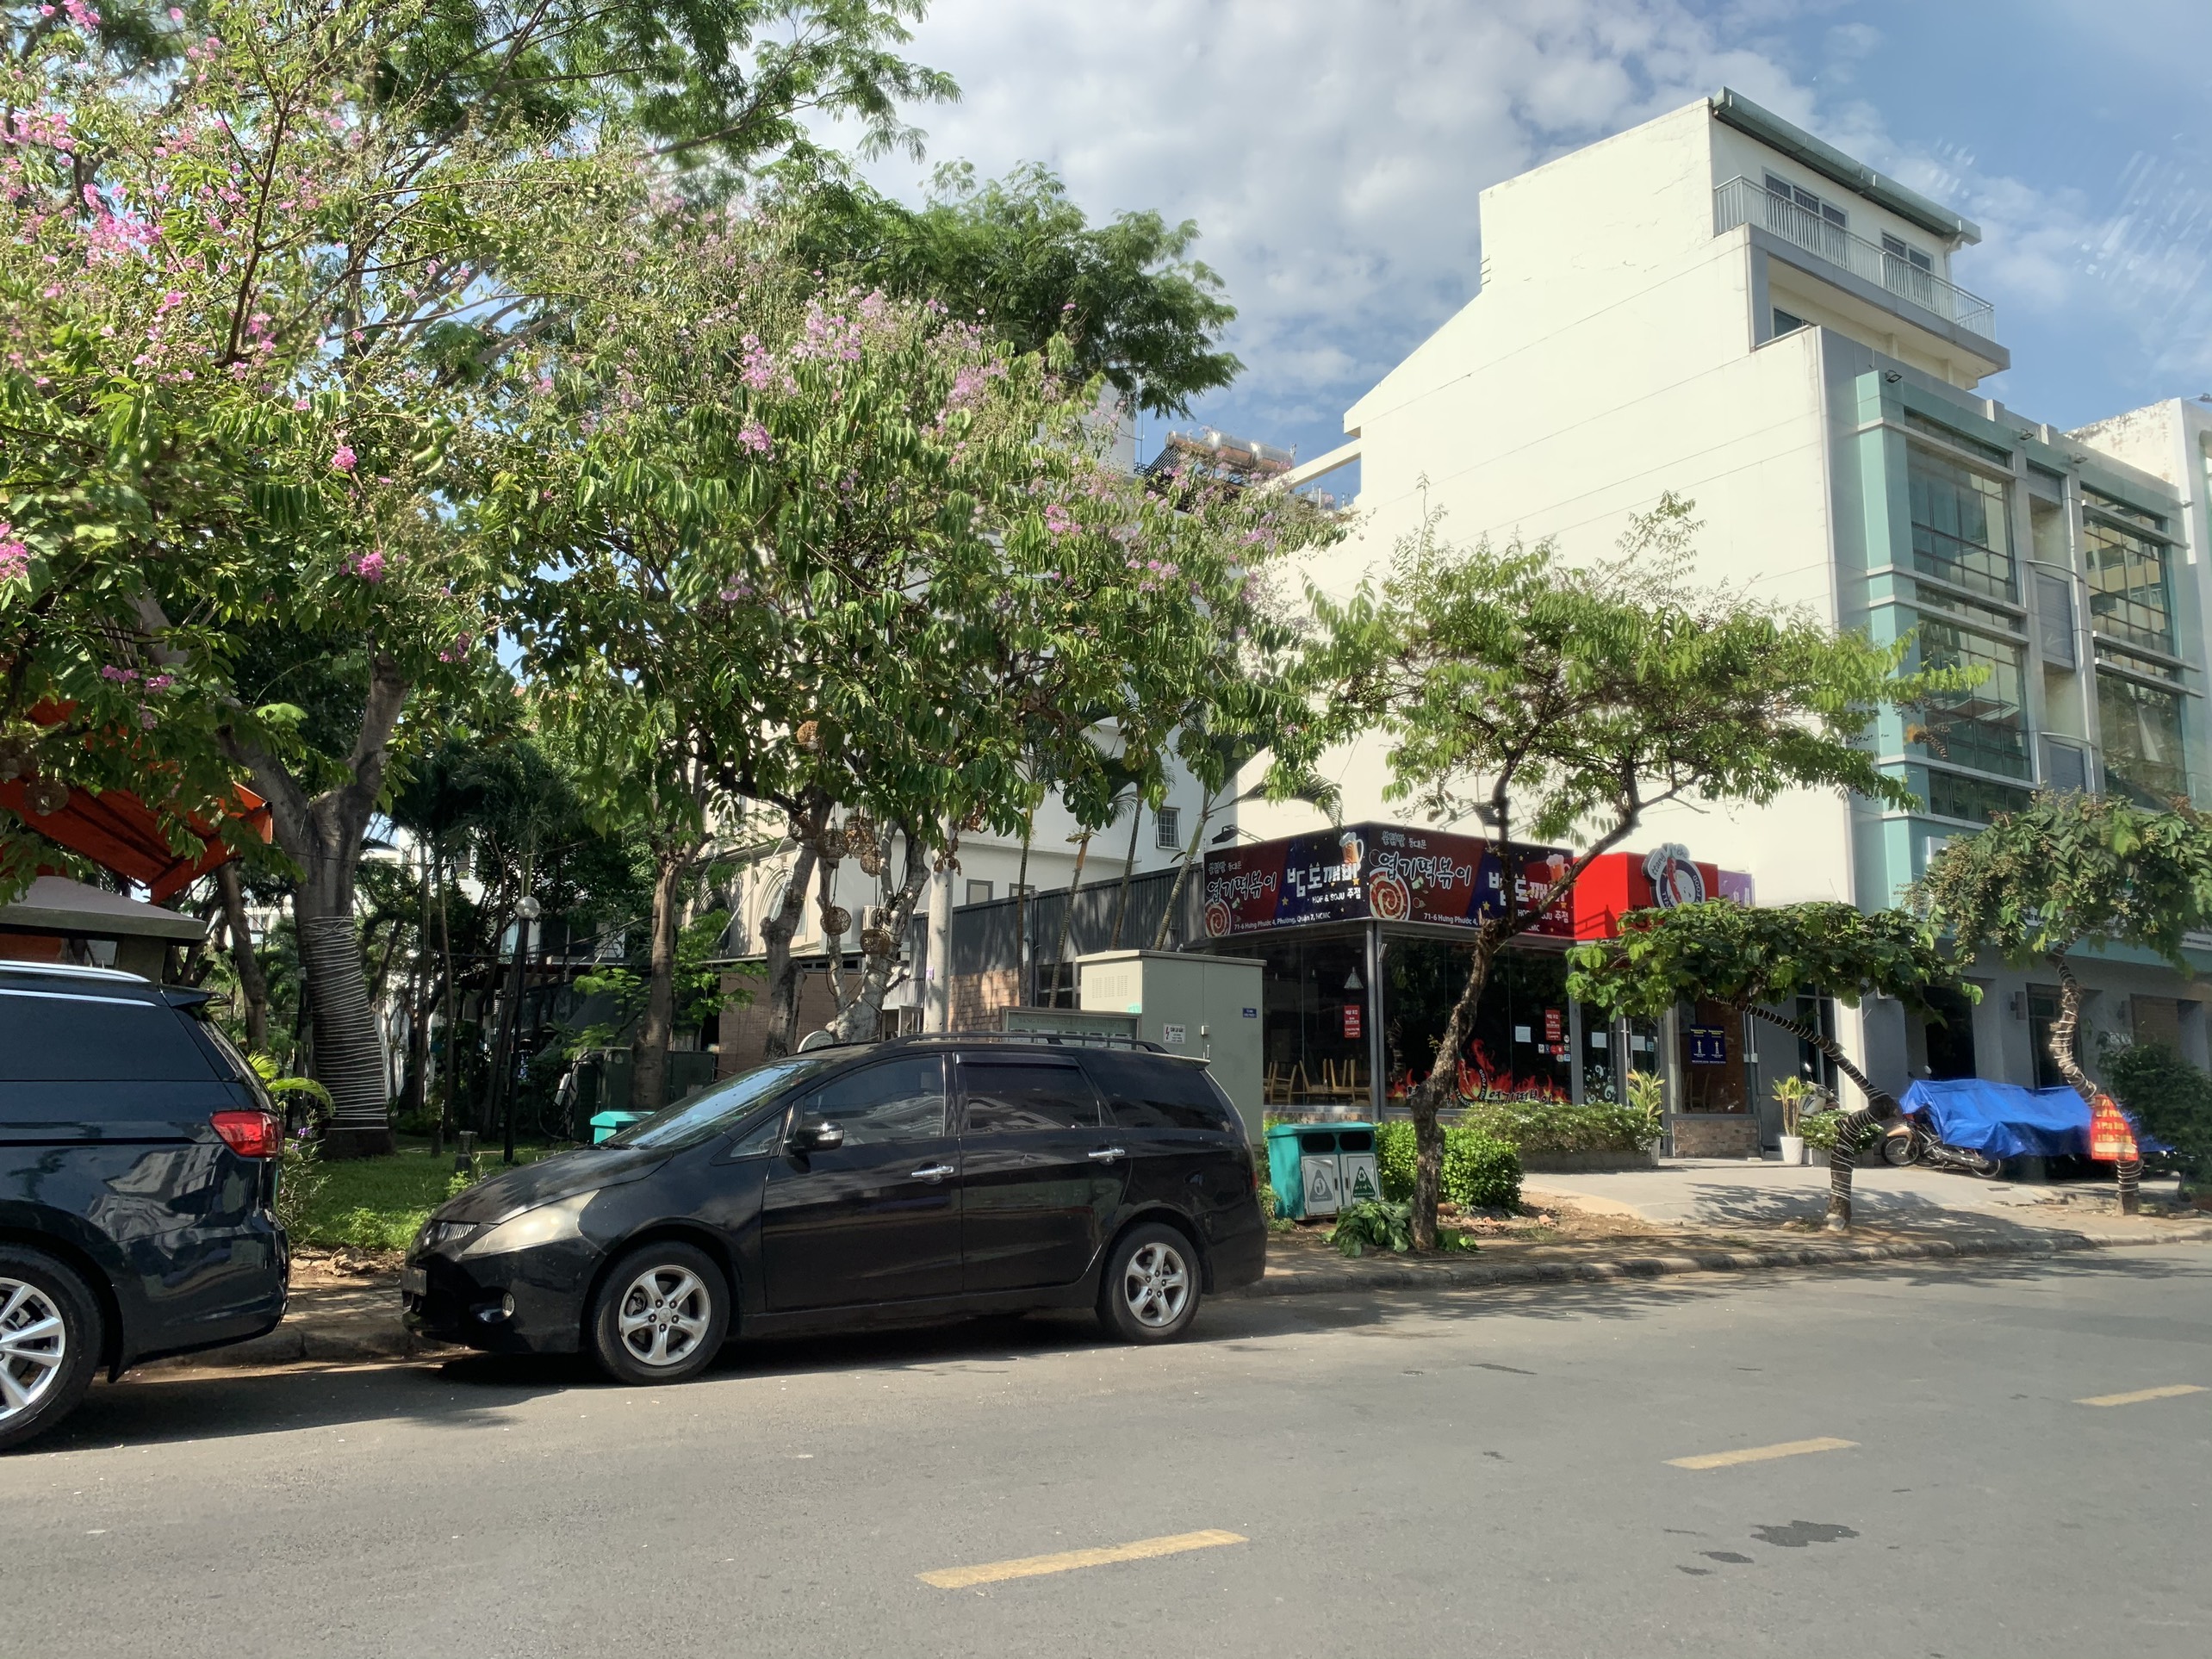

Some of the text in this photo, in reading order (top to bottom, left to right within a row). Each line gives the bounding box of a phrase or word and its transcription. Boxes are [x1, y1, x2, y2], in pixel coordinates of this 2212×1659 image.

[1408, 838, 1427, 849] 동대문
[1378, 851, 1472, 890] 엽기떡볶이
[1208, 870, 1277, 905] 엽기떡볶이
[1324, 894, 1330, 903] &
[1330, 892, 1345, 902] SOJU
[1346, 887, 1361, 900] 주점
[1423, 912, 1438, 921] 71-6
[1554, 910, 1569, 923] 주점
